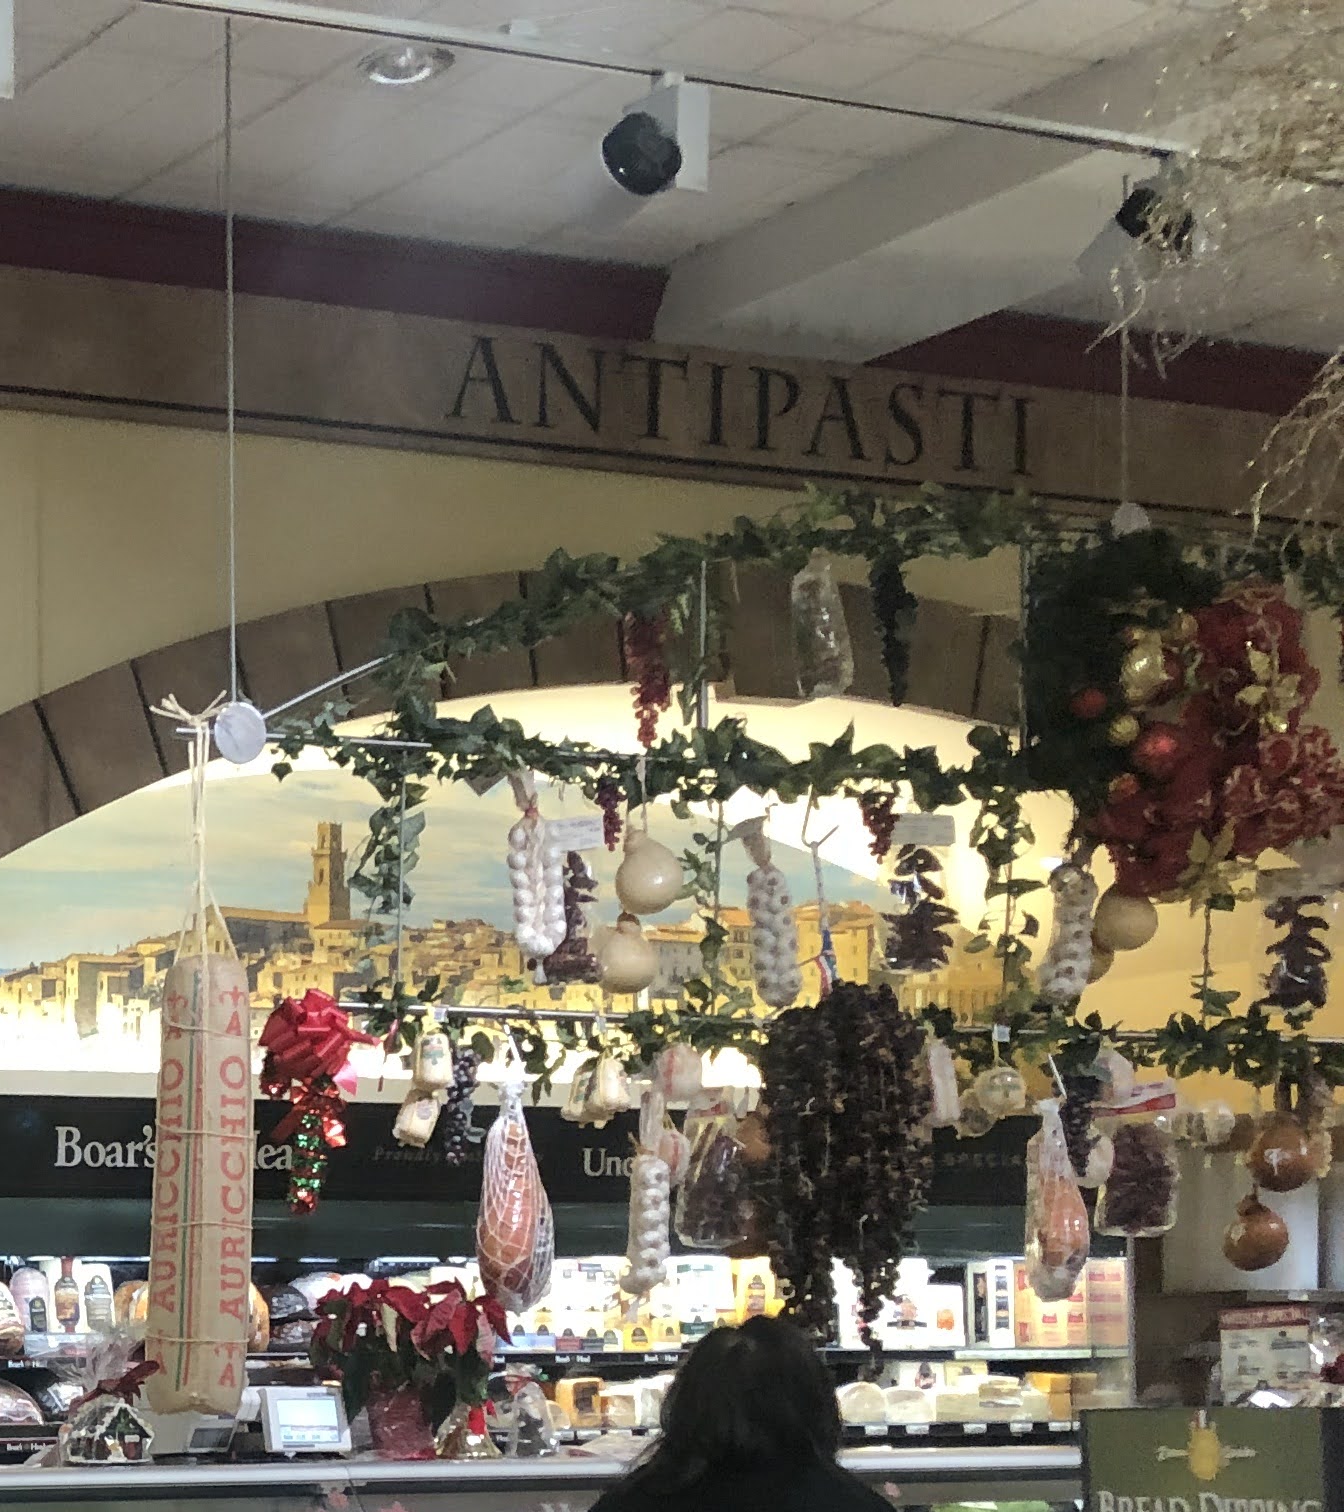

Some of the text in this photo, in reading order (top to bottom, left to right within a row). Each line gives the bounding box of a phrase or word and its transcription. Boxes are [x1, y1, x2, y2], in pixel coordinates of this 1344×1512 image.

[444, 335, 1041, 476] ANTIPASTI
[54, 1124, 158, 1169] Boar's
[219, 1054, 247, 1321] AURICCHIO
[583, 1147, 633, 1177] Unc
